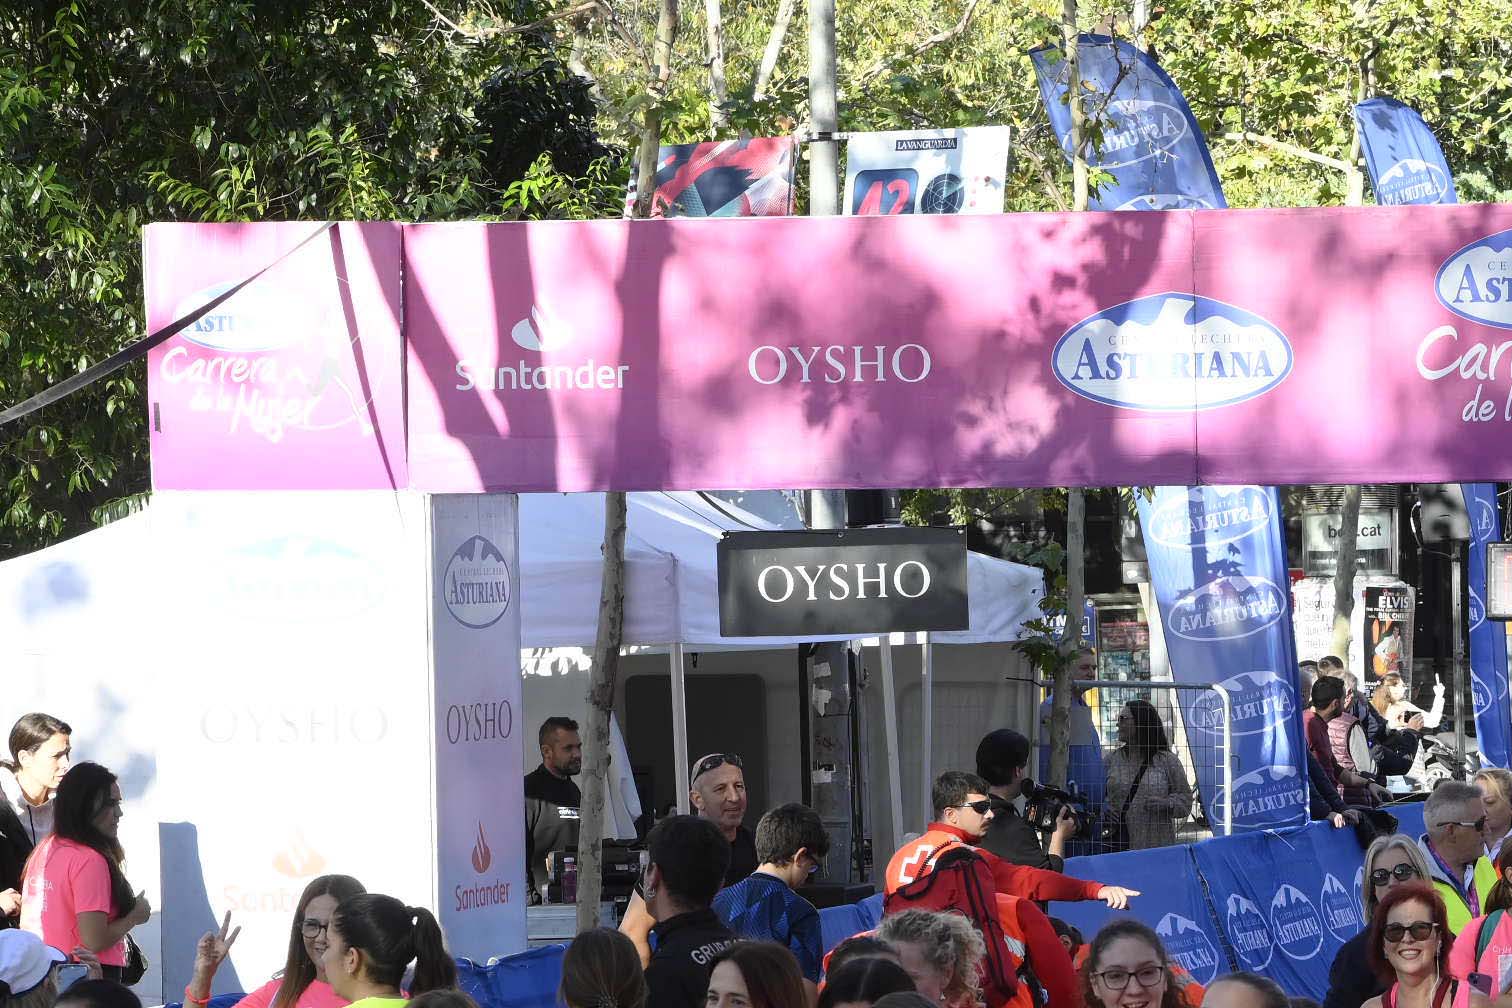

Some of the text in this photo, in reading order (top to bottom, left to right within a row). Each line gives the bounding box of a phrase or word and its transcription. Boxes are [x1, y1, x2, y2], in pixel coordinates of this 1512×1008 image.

[456, 360, 629, 391] Santander
[748, 343, 932, 385] OYSHO
[1070, 337, 1275, 381] ASTRIANA
[1462, 384, 1497, 422] de
[449, 574, 507, 606] ASTURIANA
[758, 560, 932, 604] OYSHO
[1378, 596, 1410, 609] ELVIS
[446, 699, 513, 745] OYSHO
[454, 882, 511, 913] Santander
